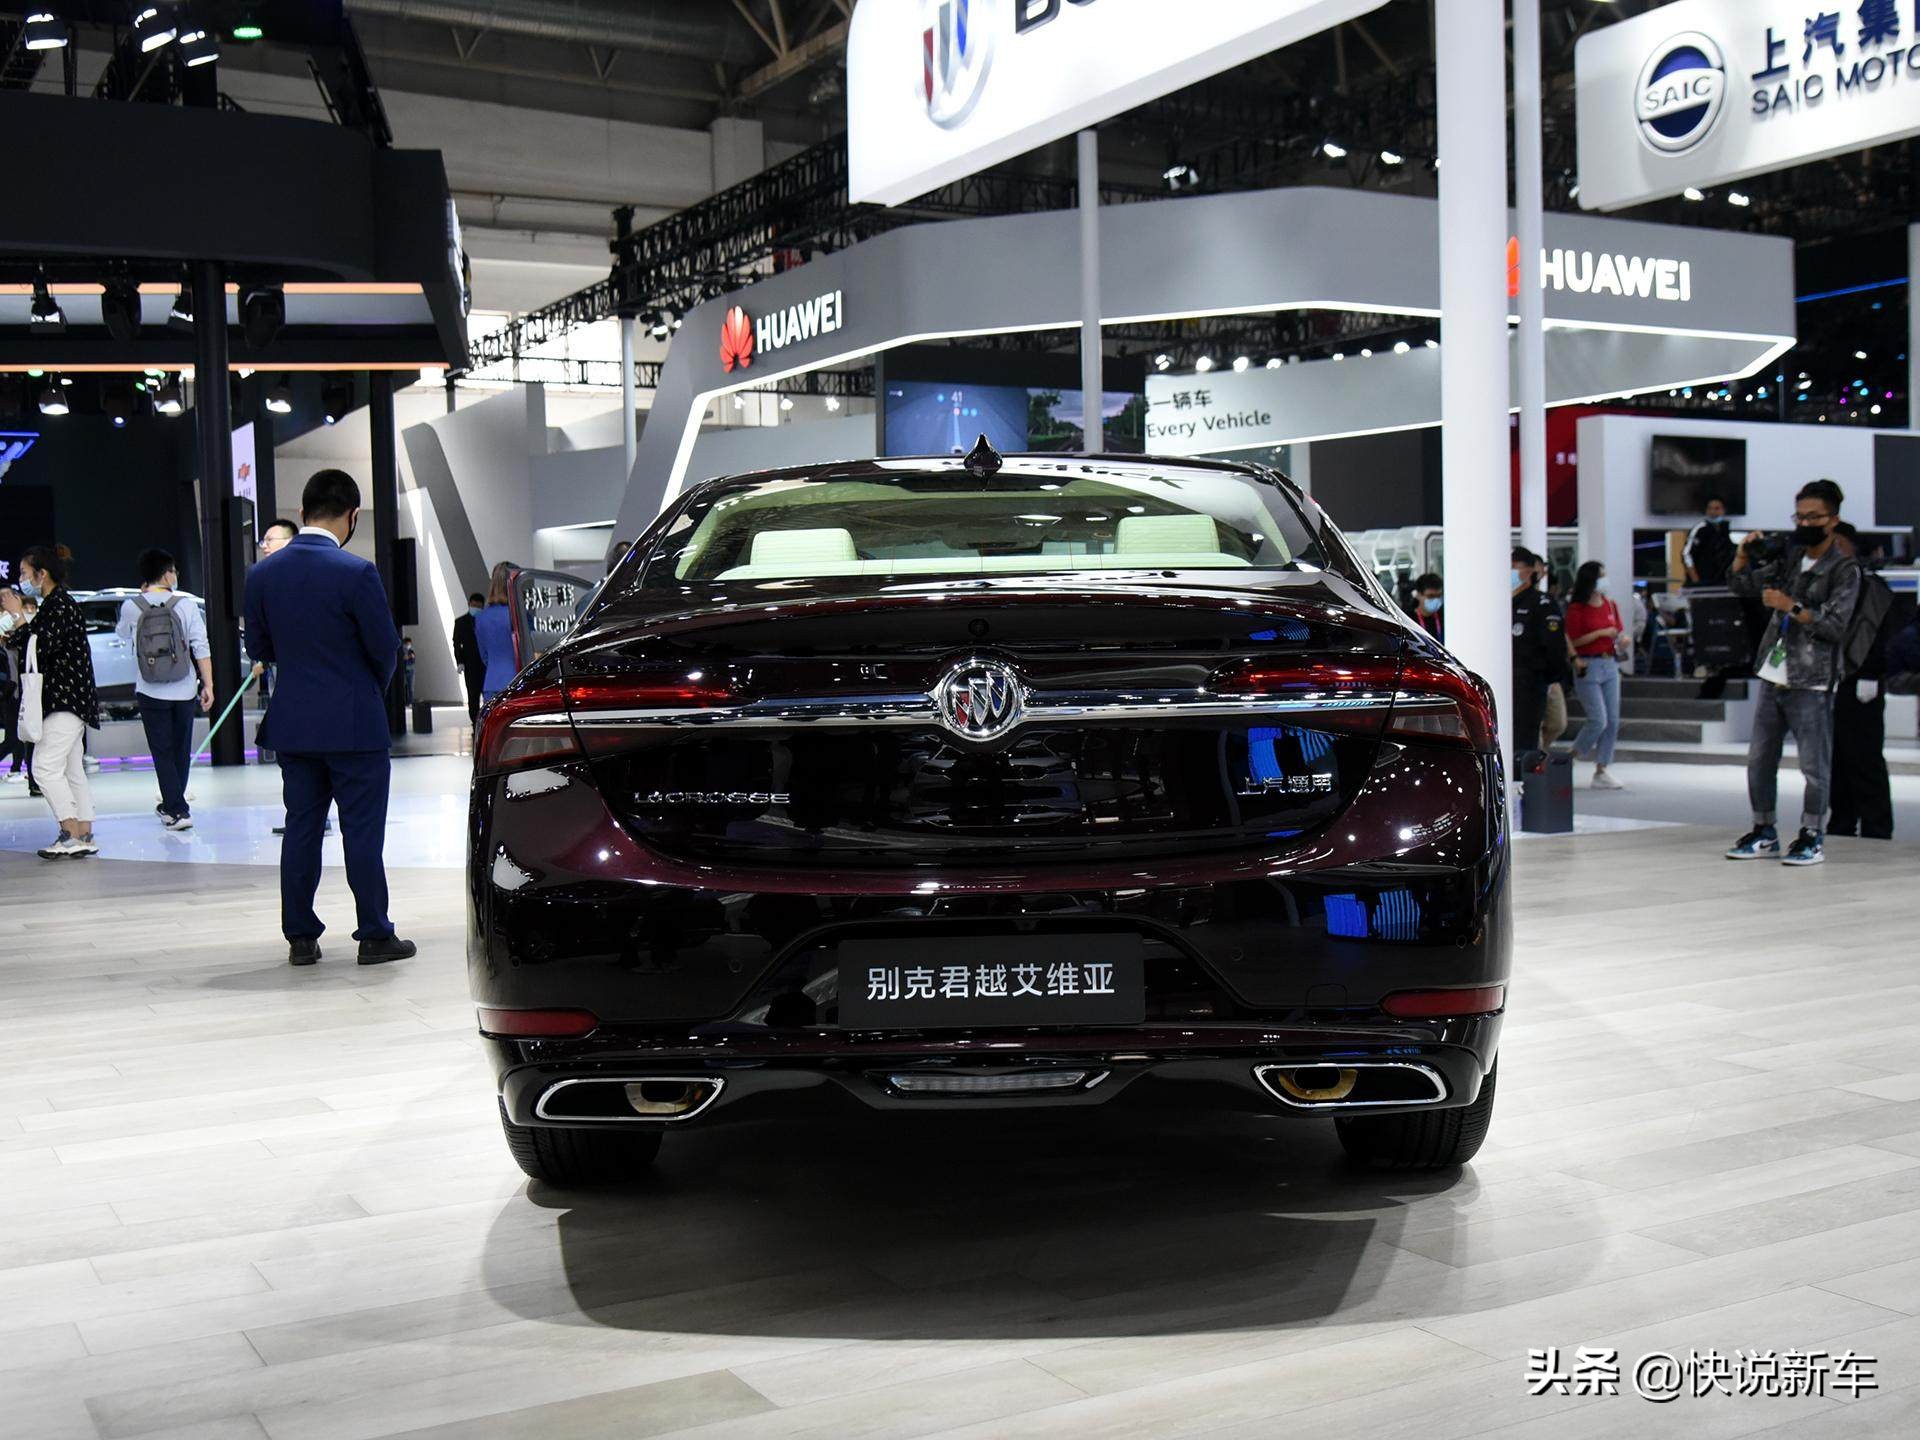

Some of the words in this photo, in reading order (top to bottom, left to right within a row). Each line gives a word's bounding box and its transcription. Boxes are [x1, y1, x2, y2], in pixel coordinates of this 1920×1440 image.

[1751, 0, 1920, 81] 上汽集
[1645, 75, 1712, 112] SAIC
[1751, 74, 1824, 116] SAIC
[1539, 248, 1691, 302] HUAWEI
[756, 289, 843, 354] HUAWEI
[1146, 421, 1197, 438] Every
[1203, 409, 1272, 431] Vehicle
[1237, 773, 1333, 796] 上汽通用
[867, 962, 1116, 1001] 别克君越艾维亚
